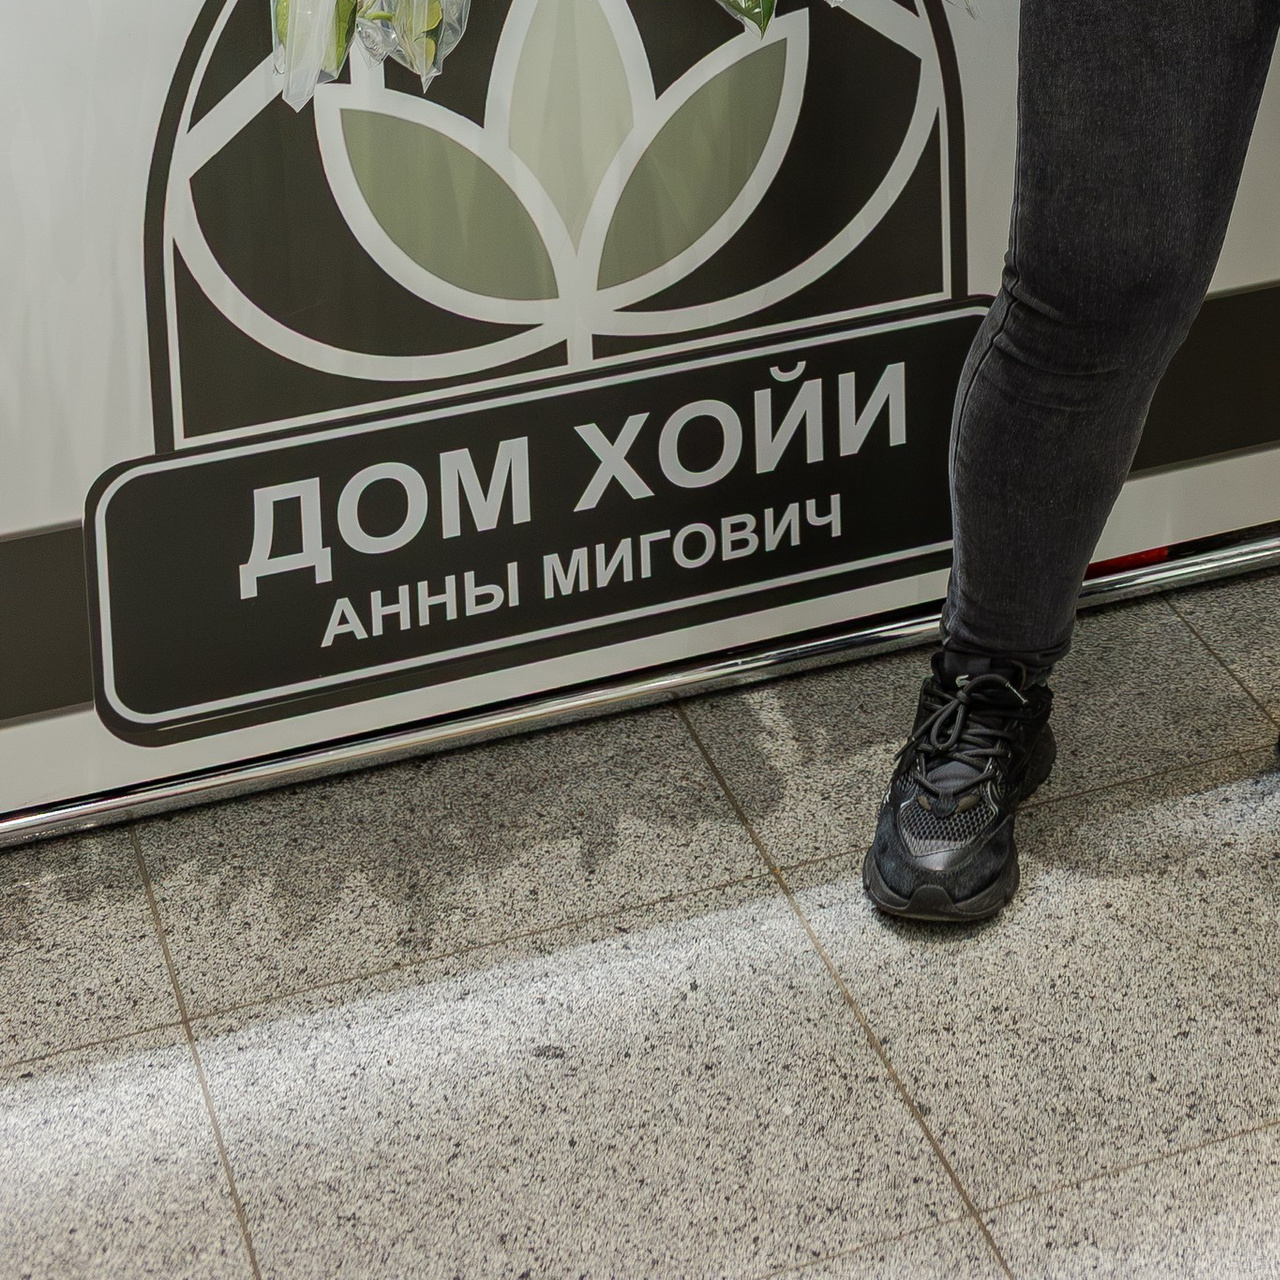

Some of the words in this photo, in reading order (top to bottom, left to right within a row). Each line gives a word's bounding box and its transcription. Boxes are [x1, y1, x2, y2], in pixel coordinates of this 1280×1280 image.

[238, 435, 532, 600] ДОМ
[574, 361, 908, 514] ХОЙИ
[319, 561, 520, 649] АННЫ
[543, 493, 843, 601] МИГОВИЧ
